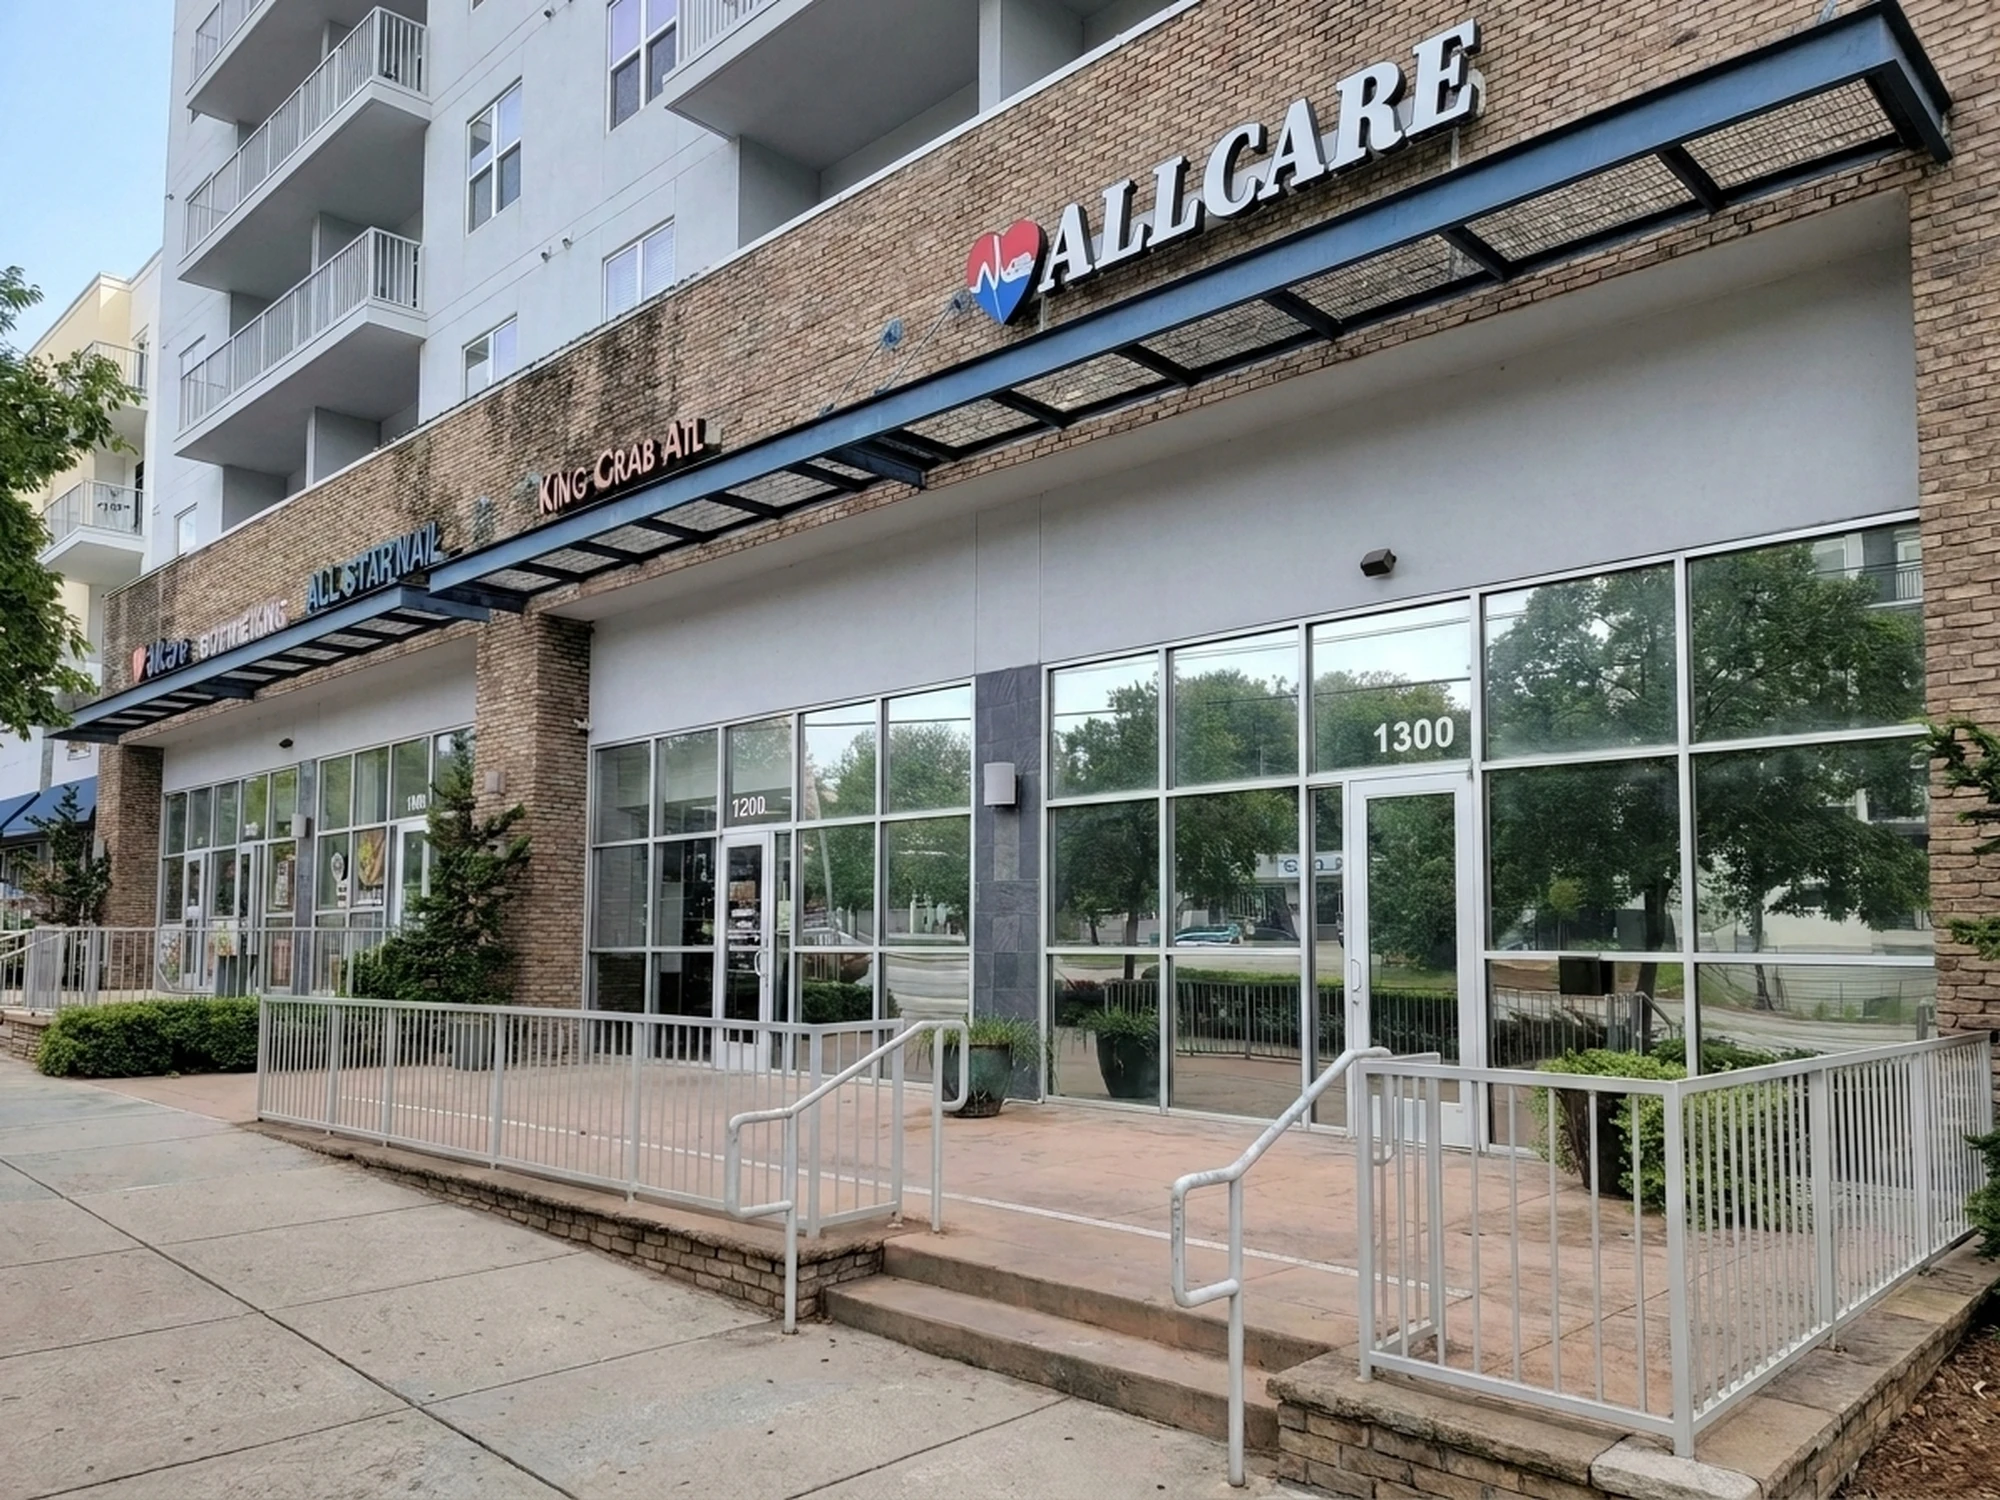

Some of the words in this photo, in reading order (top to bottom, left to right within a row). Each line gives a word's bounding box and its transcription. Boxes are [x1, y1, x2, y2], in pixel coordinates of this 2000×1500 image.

[1037, 18, 1479, 292] ALLCARE
[539, 466, 587, 514] KING
[593, 440, 654, 490] CRAB
[661, 418, 704, 466] ATL
[306, 564, 340, 615] ALL
[340, 537, 399, 598] STAR
[1373, 716, 1454, 753] 1300
[732, 796, 766, 818] 1200
